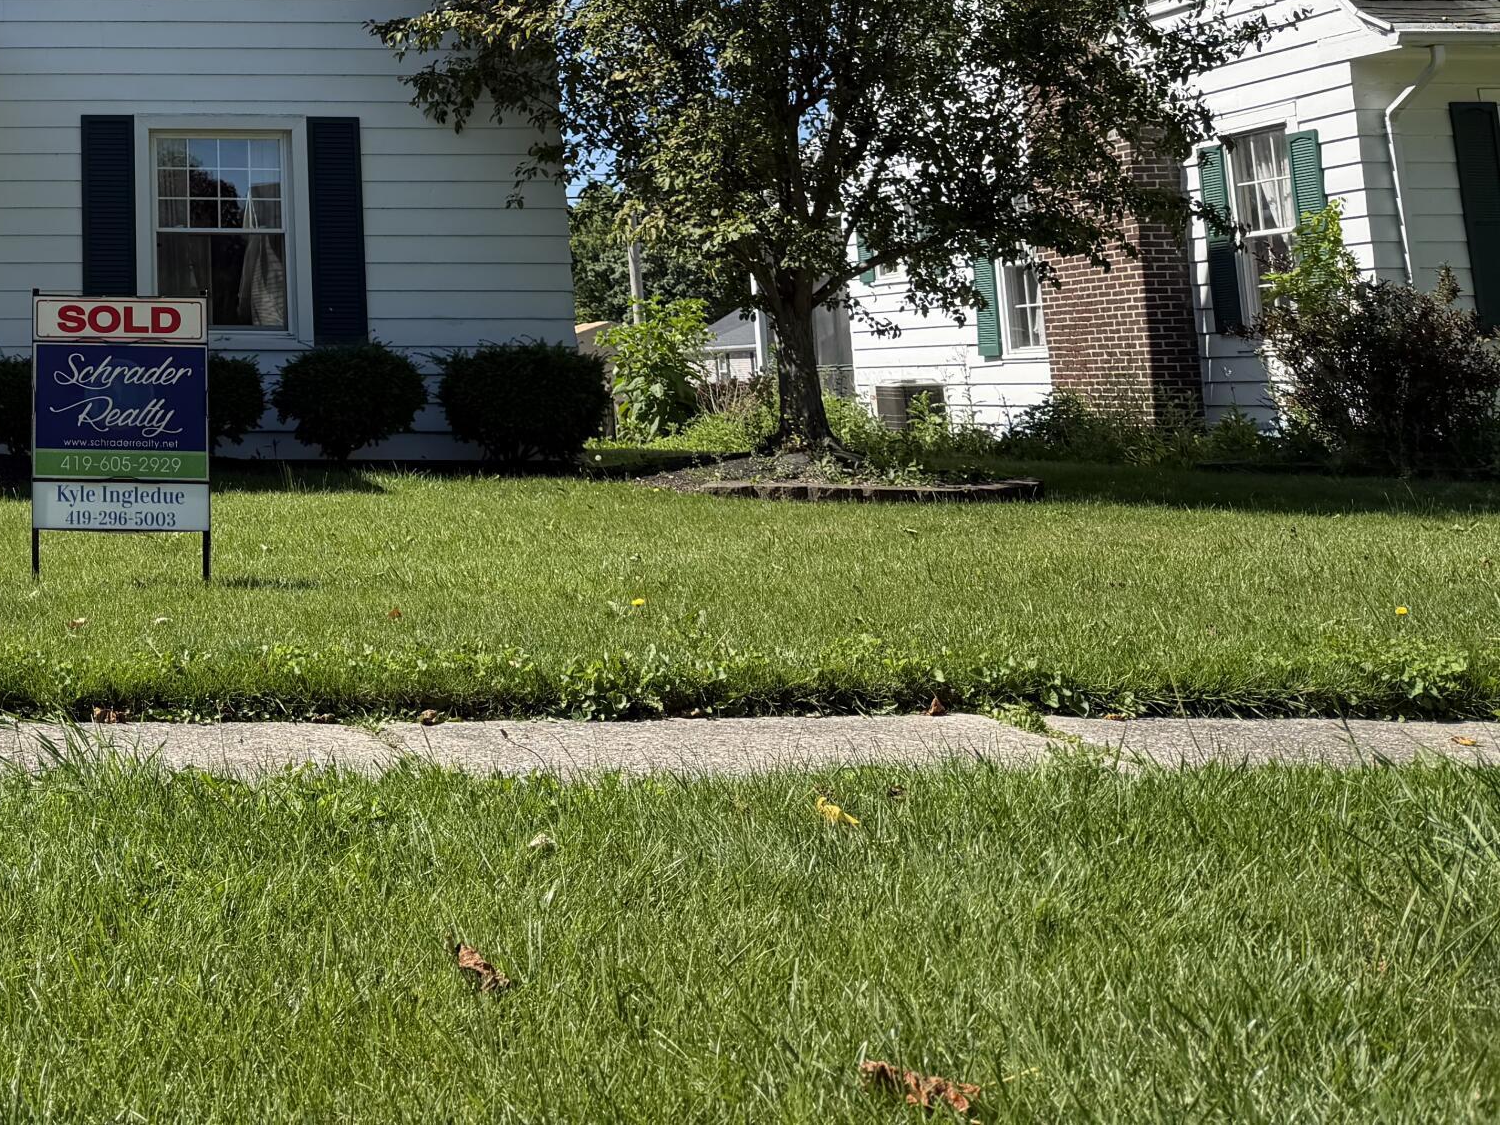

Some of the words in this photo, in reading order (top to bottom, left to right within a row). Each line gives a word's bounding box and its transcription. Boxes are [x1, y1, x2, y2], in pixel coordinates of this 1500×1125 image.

[57, 305, 181, 334] SOLD
[53, 353, 192, 390] Schrader
[49, 396, 183, 438] Realty
[63, 438, 179, 449] www.schraderrealty.net
[60, 455, 182, 473] 419-605-2929
[56, 484, 96, 507] Kyle
[101, 485, 185, 509] Ingledue
[65, 510, 177, 528] 419-296-5003
